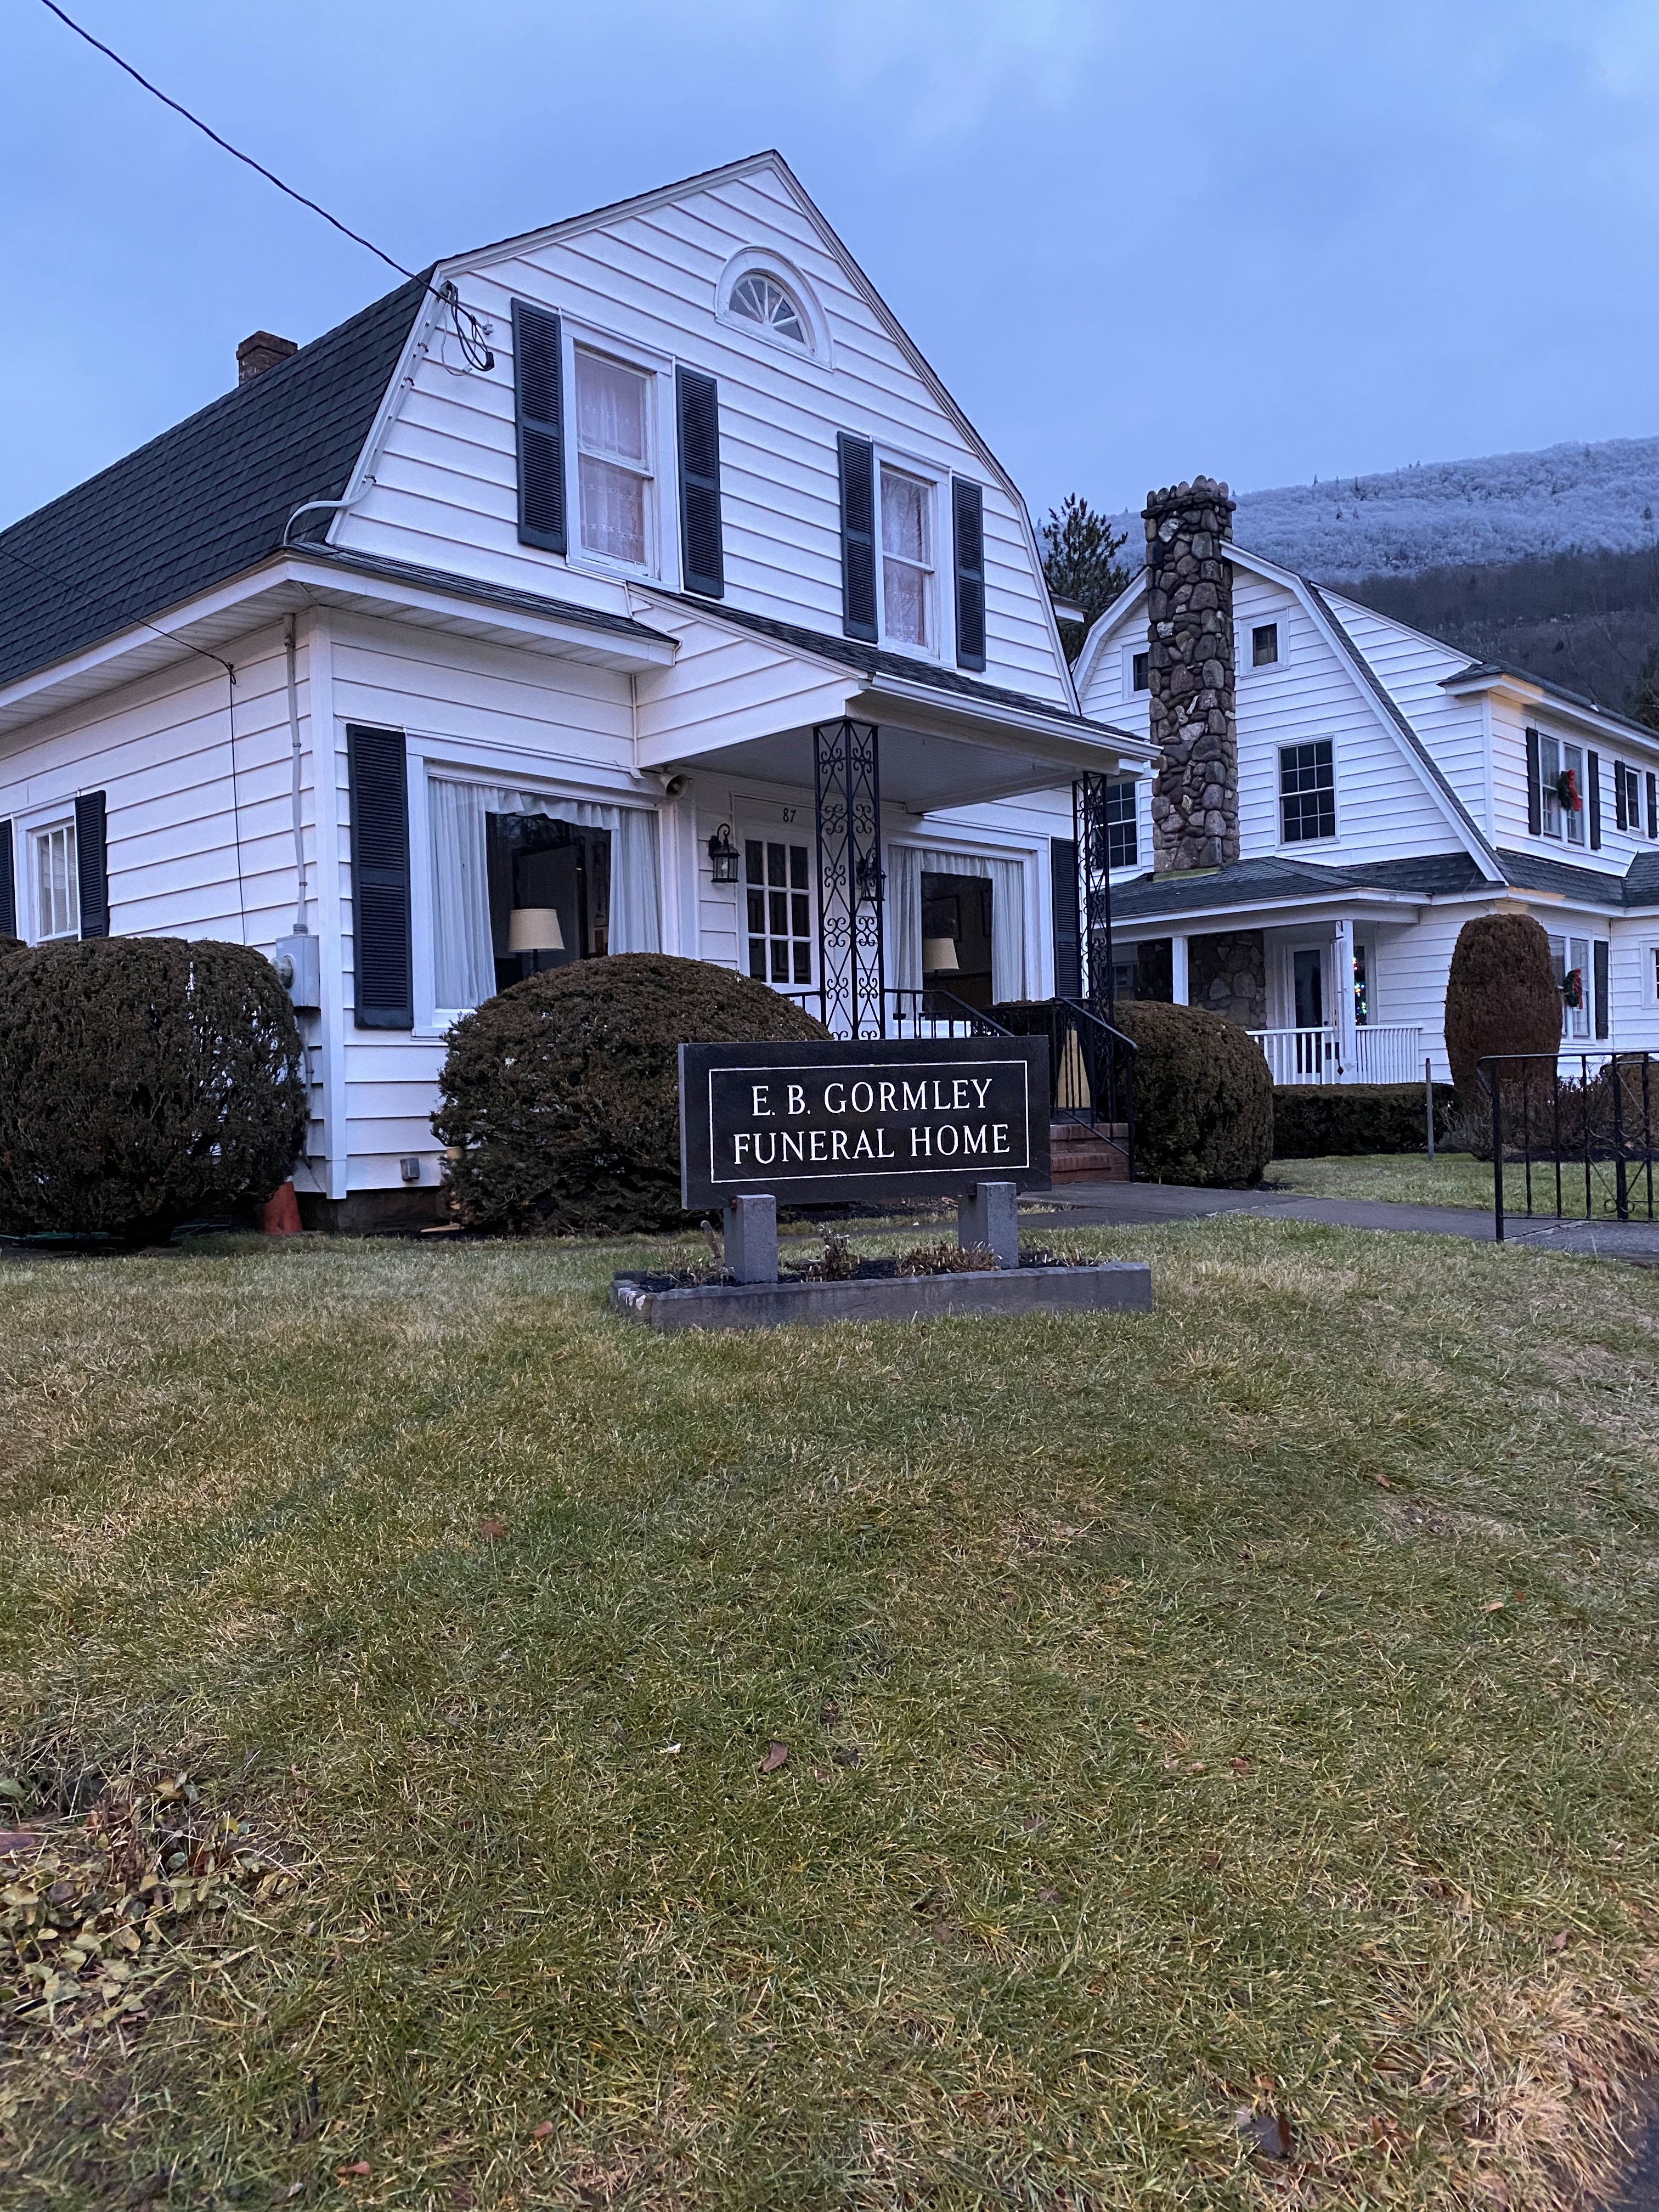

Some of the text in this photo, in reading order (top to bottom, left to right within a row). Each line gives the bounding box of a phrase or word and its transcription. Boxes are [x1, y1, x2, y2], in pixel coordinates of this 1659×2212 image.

[783, 808, 796, 823] 87
[751, 1078, 992, 1116] E. B. GORMLEY
[733, 1124, 1010, 1165] FUNERAL HOME
